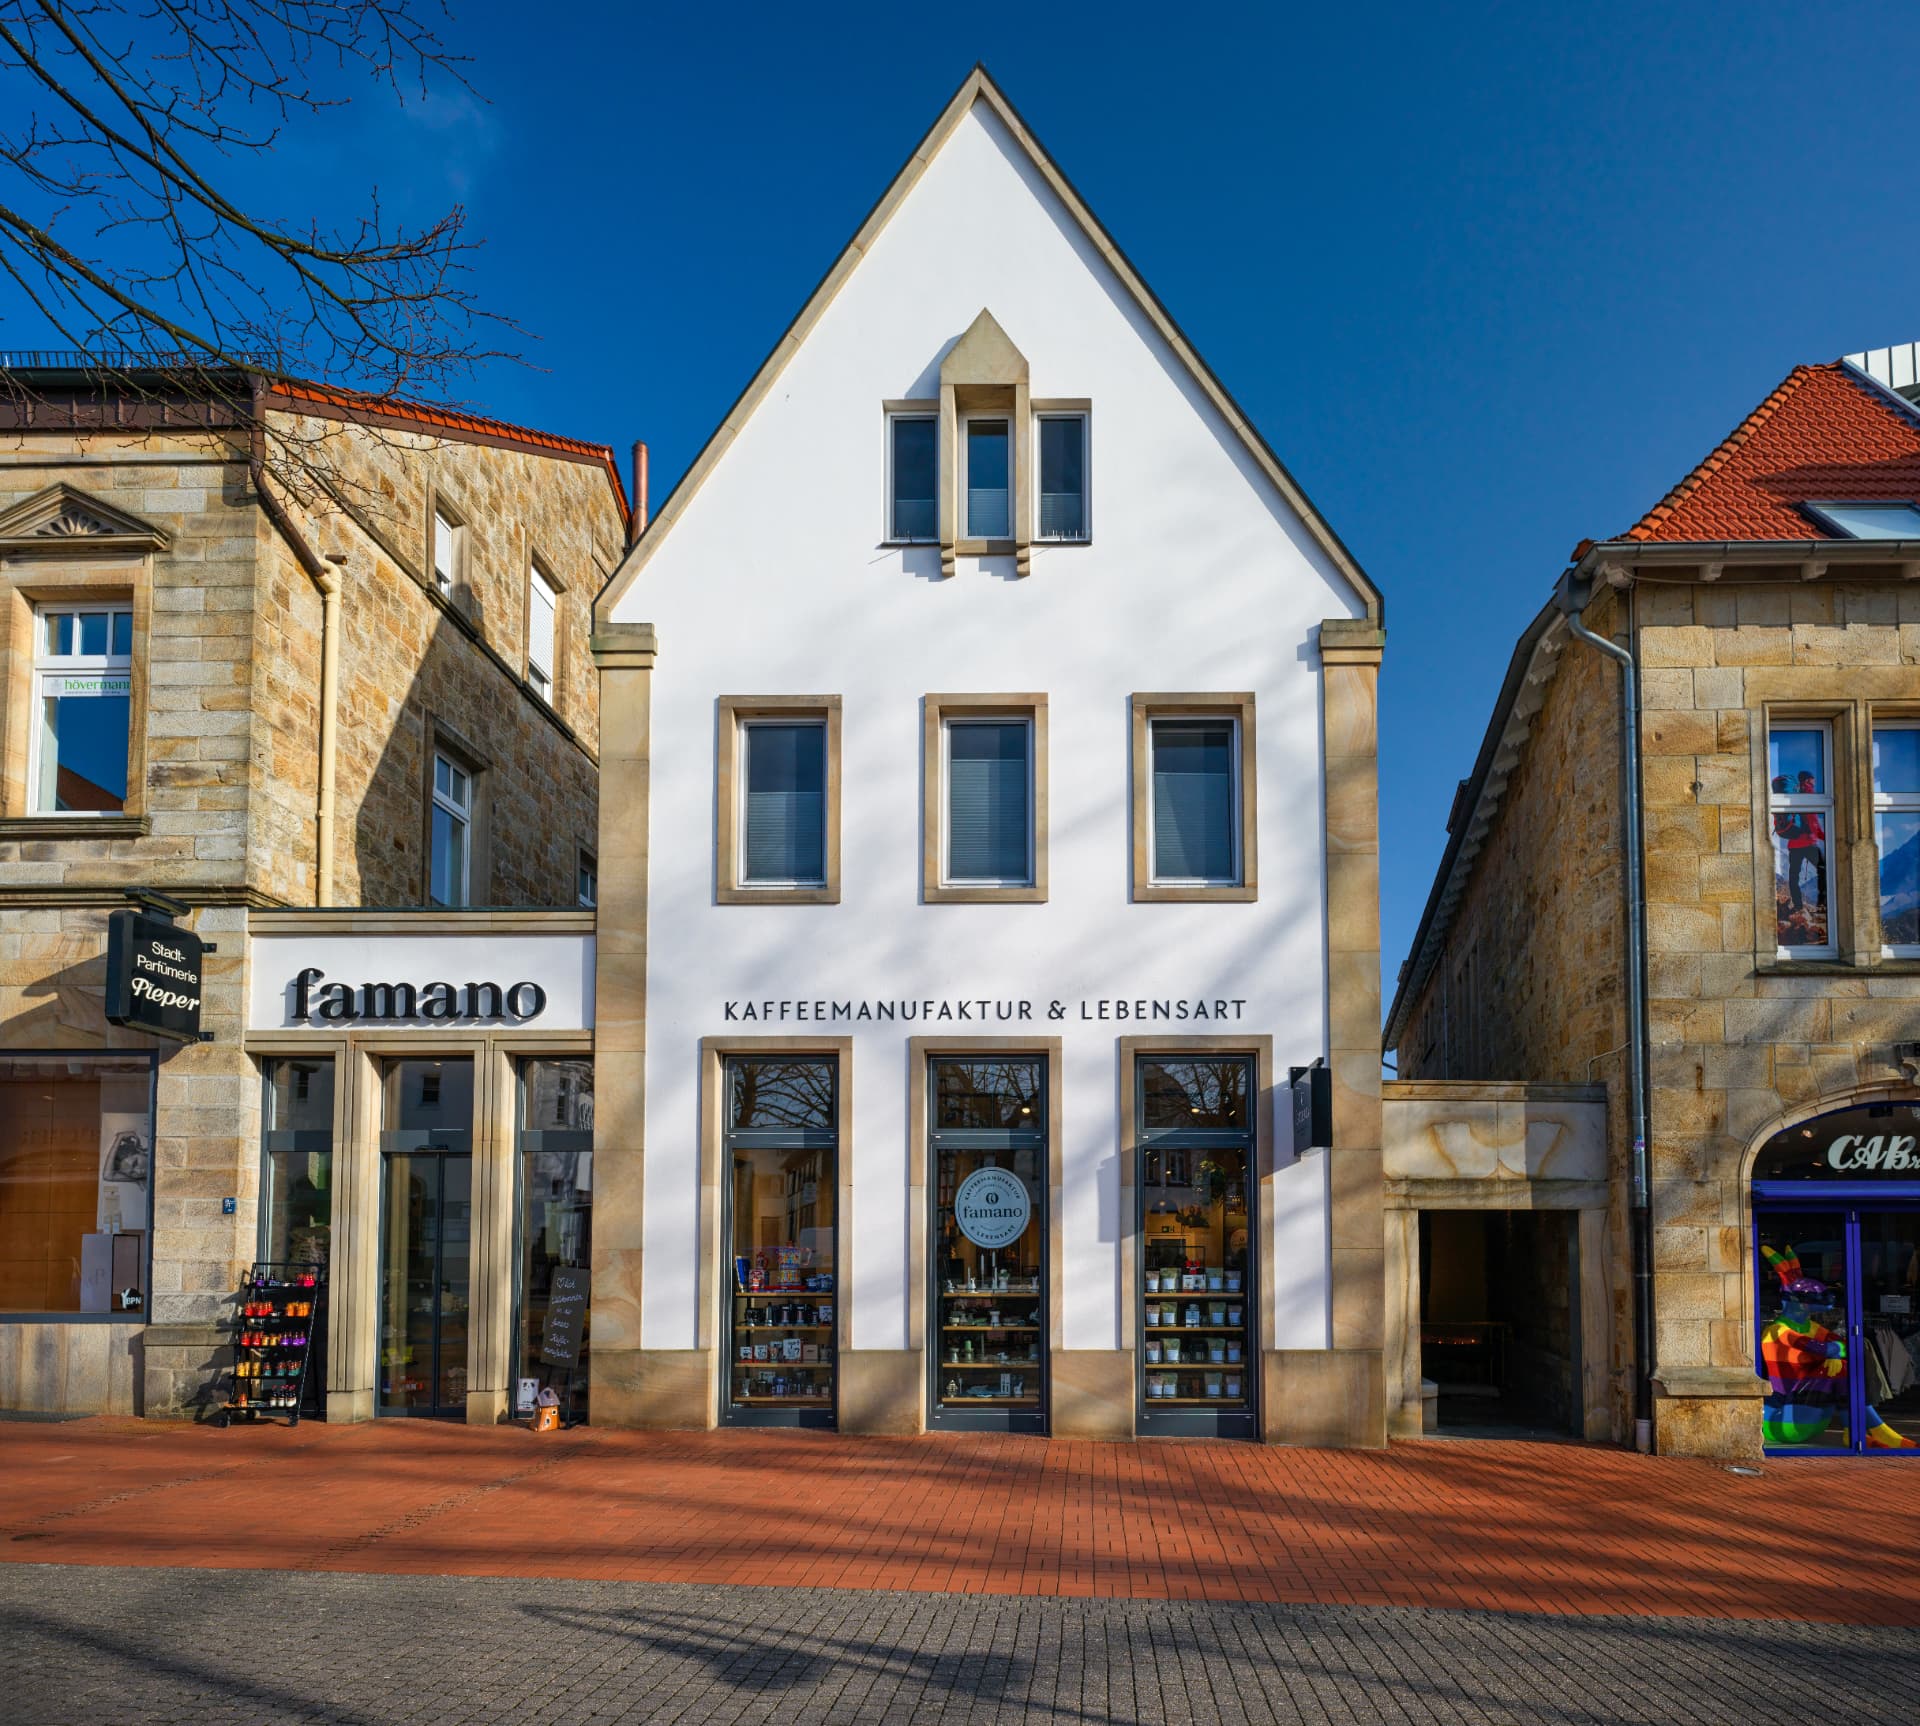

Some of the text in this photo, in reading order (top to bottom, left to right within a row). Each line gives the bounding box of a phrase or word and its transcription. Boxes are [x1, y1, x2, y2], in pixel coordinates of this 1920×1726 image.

[151, 941, 187, 962] Stadt-
[136, 953, 198, 984] Parfümerie
[131, 977, 200, 1011] Pieper
[291, 967, 547, 1021] famano
[724, 1000, 1247, 1021] KAFFEEMANUFAKTUR & LEBENSART
[964, 1205, 1023, 1218] famano
